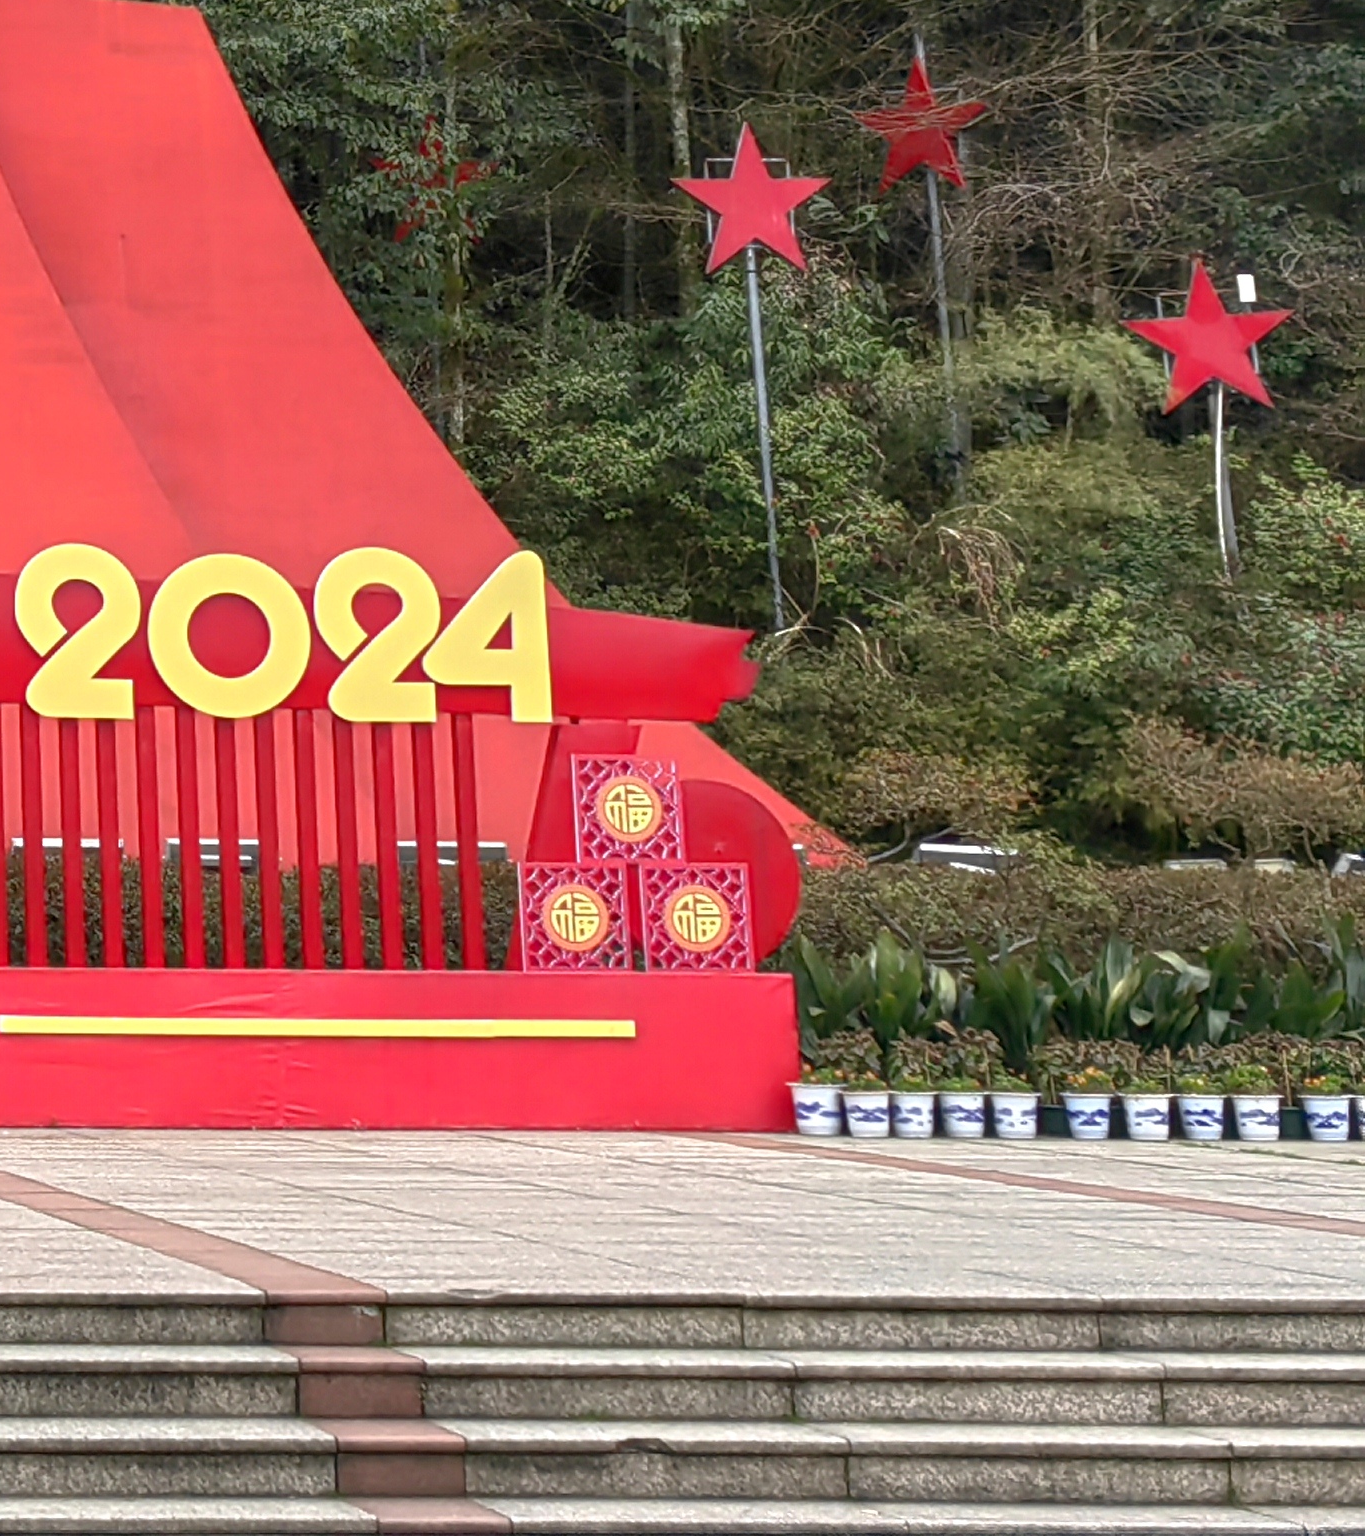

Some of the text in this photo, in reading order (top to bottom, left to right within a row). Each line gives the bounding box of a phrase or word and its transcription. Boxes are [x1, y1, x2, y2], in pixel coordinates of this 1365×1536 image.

[14, 542, 554, 724] 2024
[604, 783, 655, 835] 福
[550, 892, 601, 943] 福
[672, 893, 723, 943] 福
